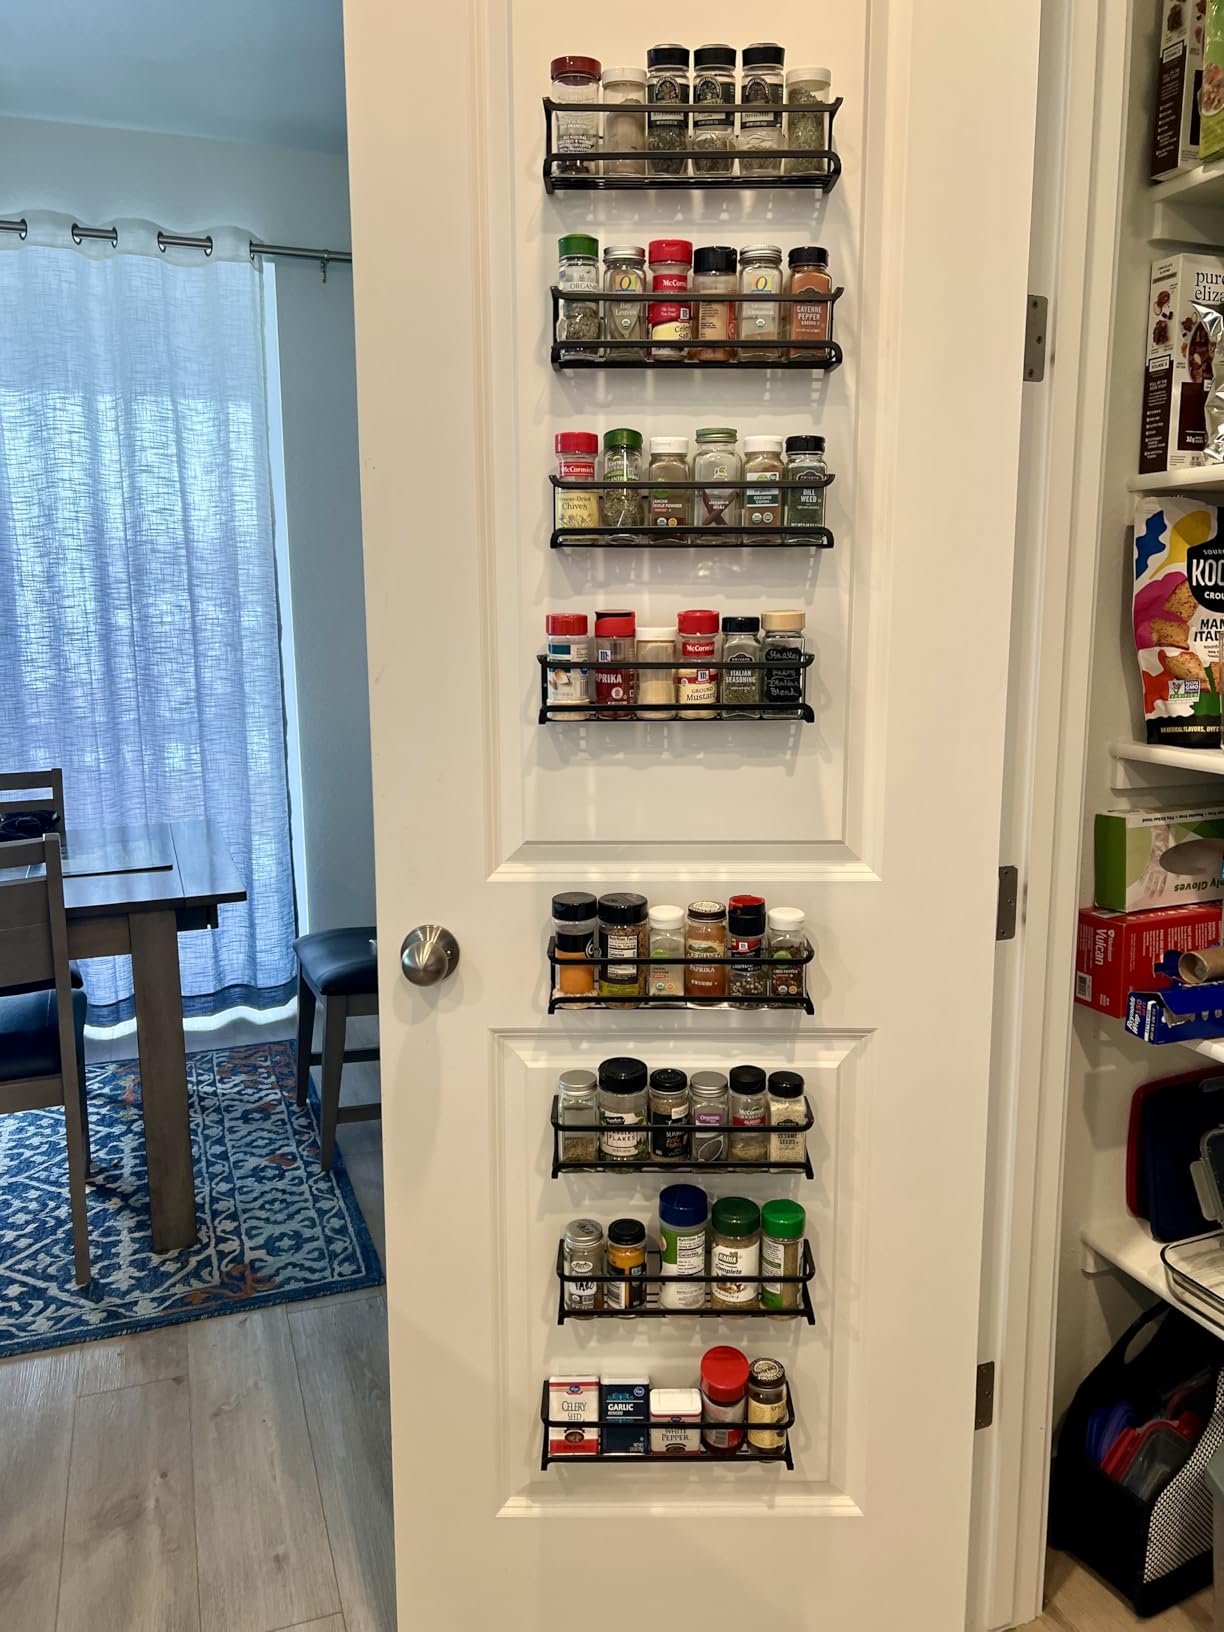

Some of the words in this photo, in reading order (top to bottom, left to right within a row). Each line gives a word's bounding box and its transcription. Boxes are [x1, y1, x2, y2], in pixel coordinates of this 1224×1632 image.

[800, 495, 817, 503] WEED
[562, 502, 588, 511] Chives
[691, 686, 714, 694] GROUND
[770, 687, 799, 696] Blend
[1174, 880, 1209, 892] Gloves
[1094, 929, 1107, 965] Vulcan
[689, 964, 715, 973] PAPRIKA
[715, 1263, 742, 1274] Complete
[561, 1401, 587, 1412] CELERY
[607, 1403, 634, 1411] GARLIC
